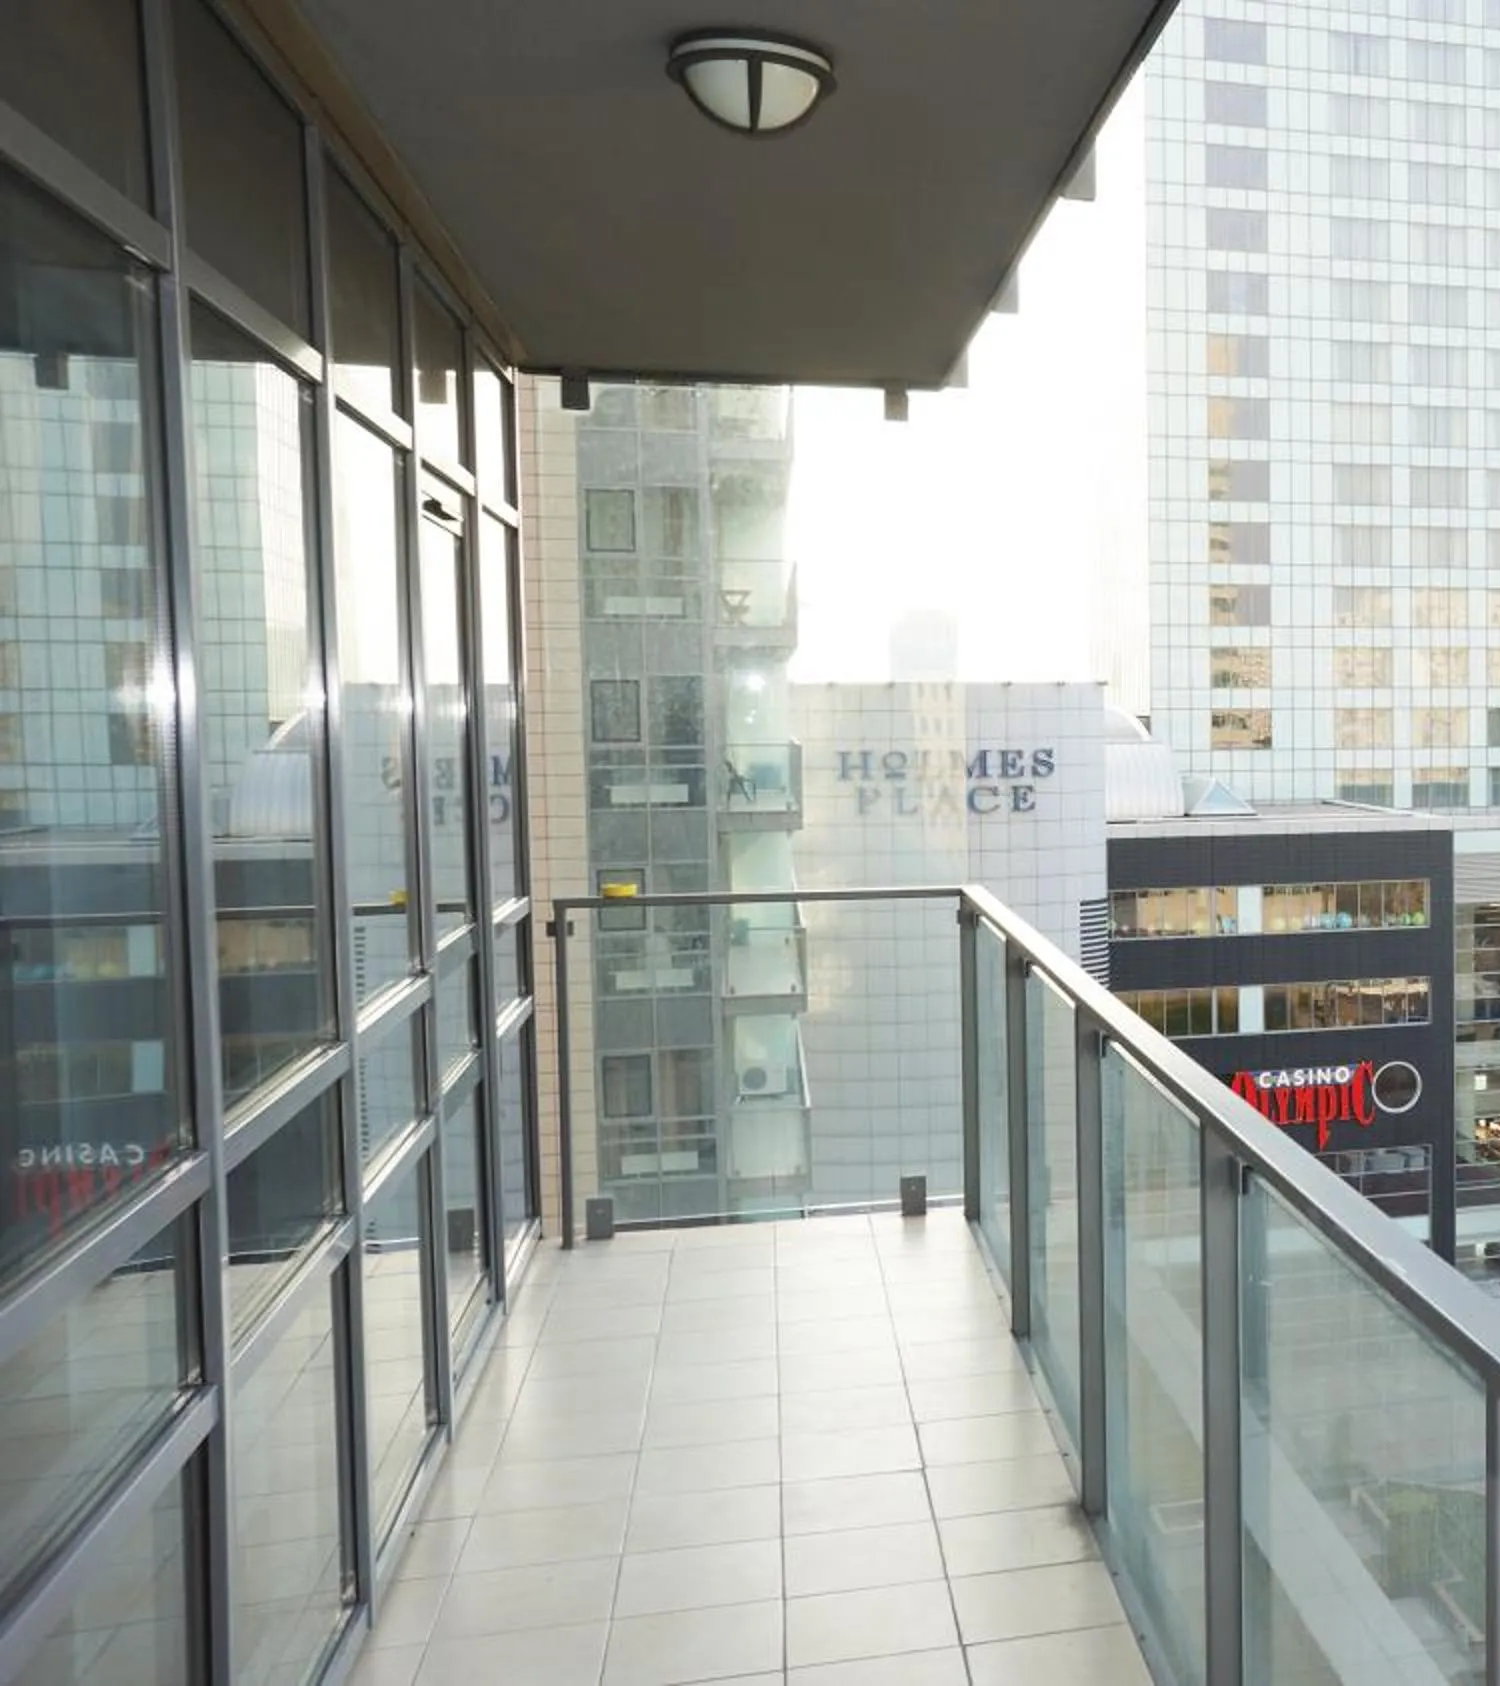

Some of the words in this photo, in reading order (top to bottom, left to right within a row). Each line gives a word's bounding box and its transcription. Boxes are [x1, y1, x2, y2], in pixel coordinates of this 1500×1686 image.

[837, 748, 1056, 781] HOLMES
[856, 784, 1037, 816] PLACE
[1258, 1066, 1351, 1088] CASINO
